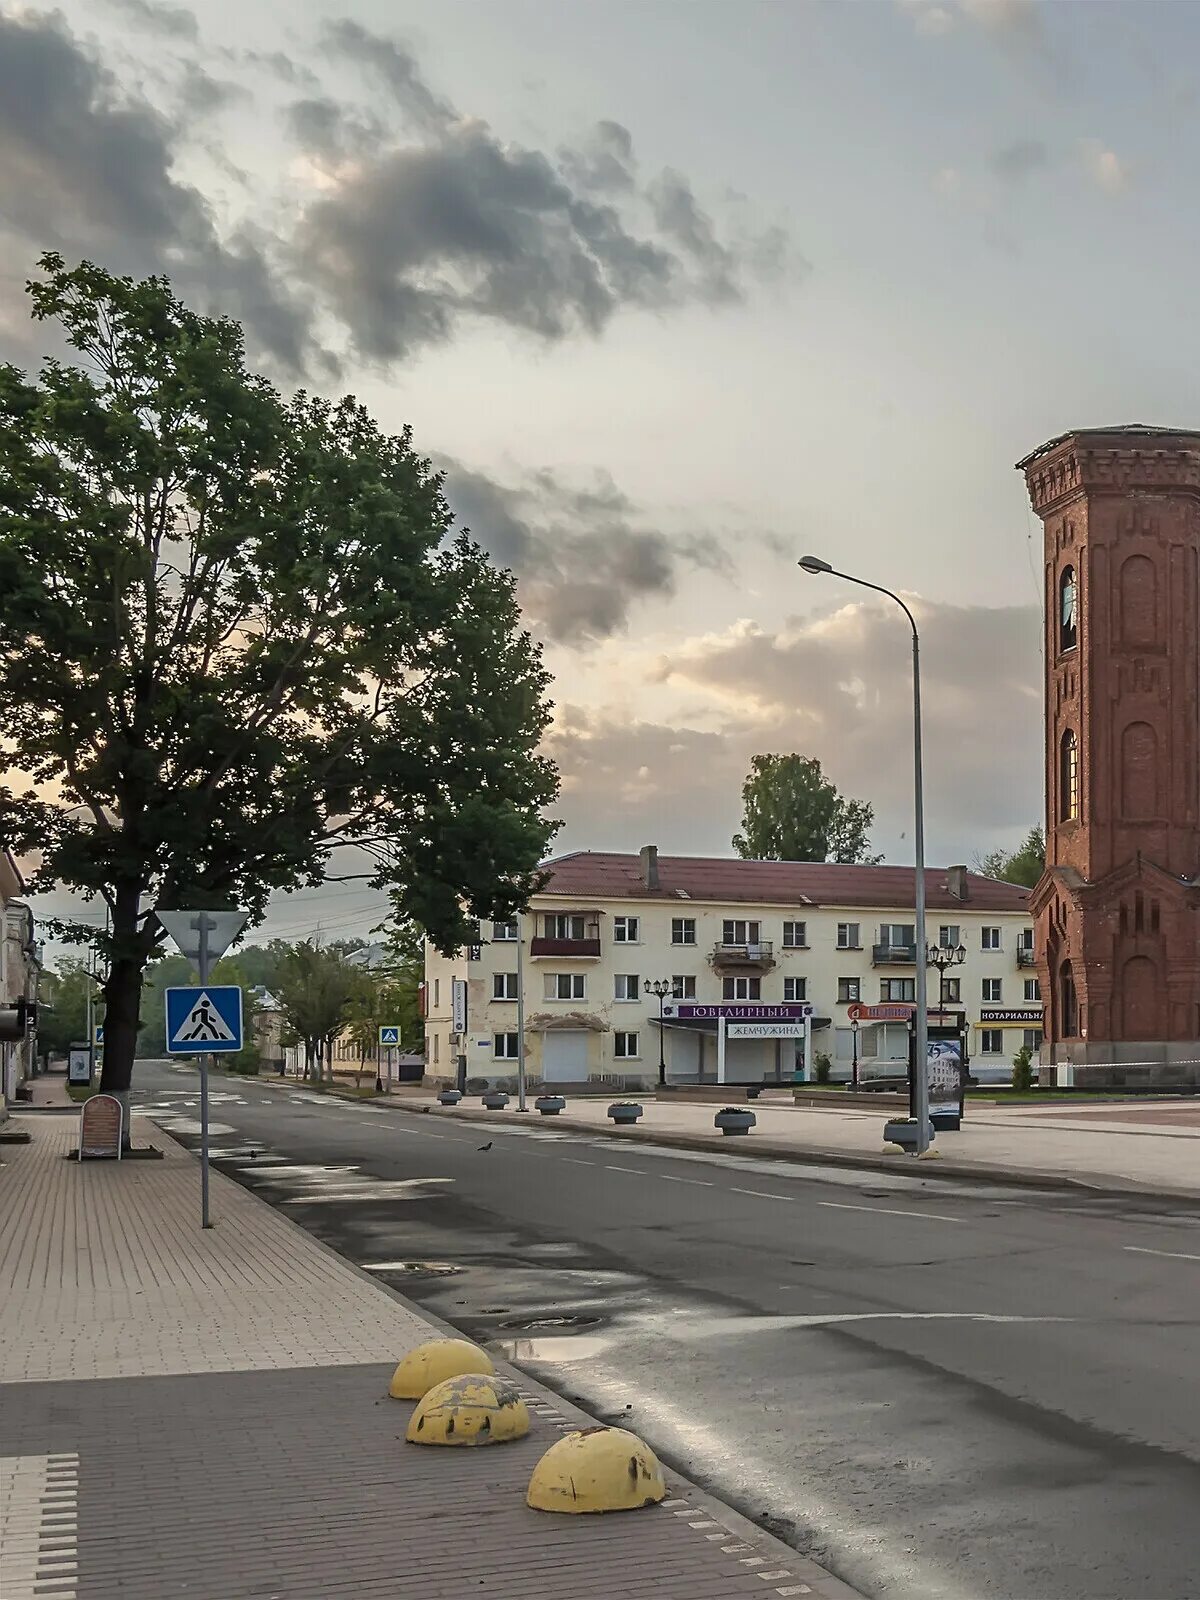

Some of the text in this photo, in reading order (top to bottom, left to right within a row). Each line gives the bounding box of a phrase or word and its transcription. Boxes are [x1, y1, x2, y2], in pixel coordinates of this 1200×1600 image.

[692, 1006, 790, 1017] ЮВЕЛИРНЫЙ
[982, 1012, 1043, 1020] НОТАРИАЛЬНА
[733, 1026, 800, 1036] ЖЕМЧУЖИНА
